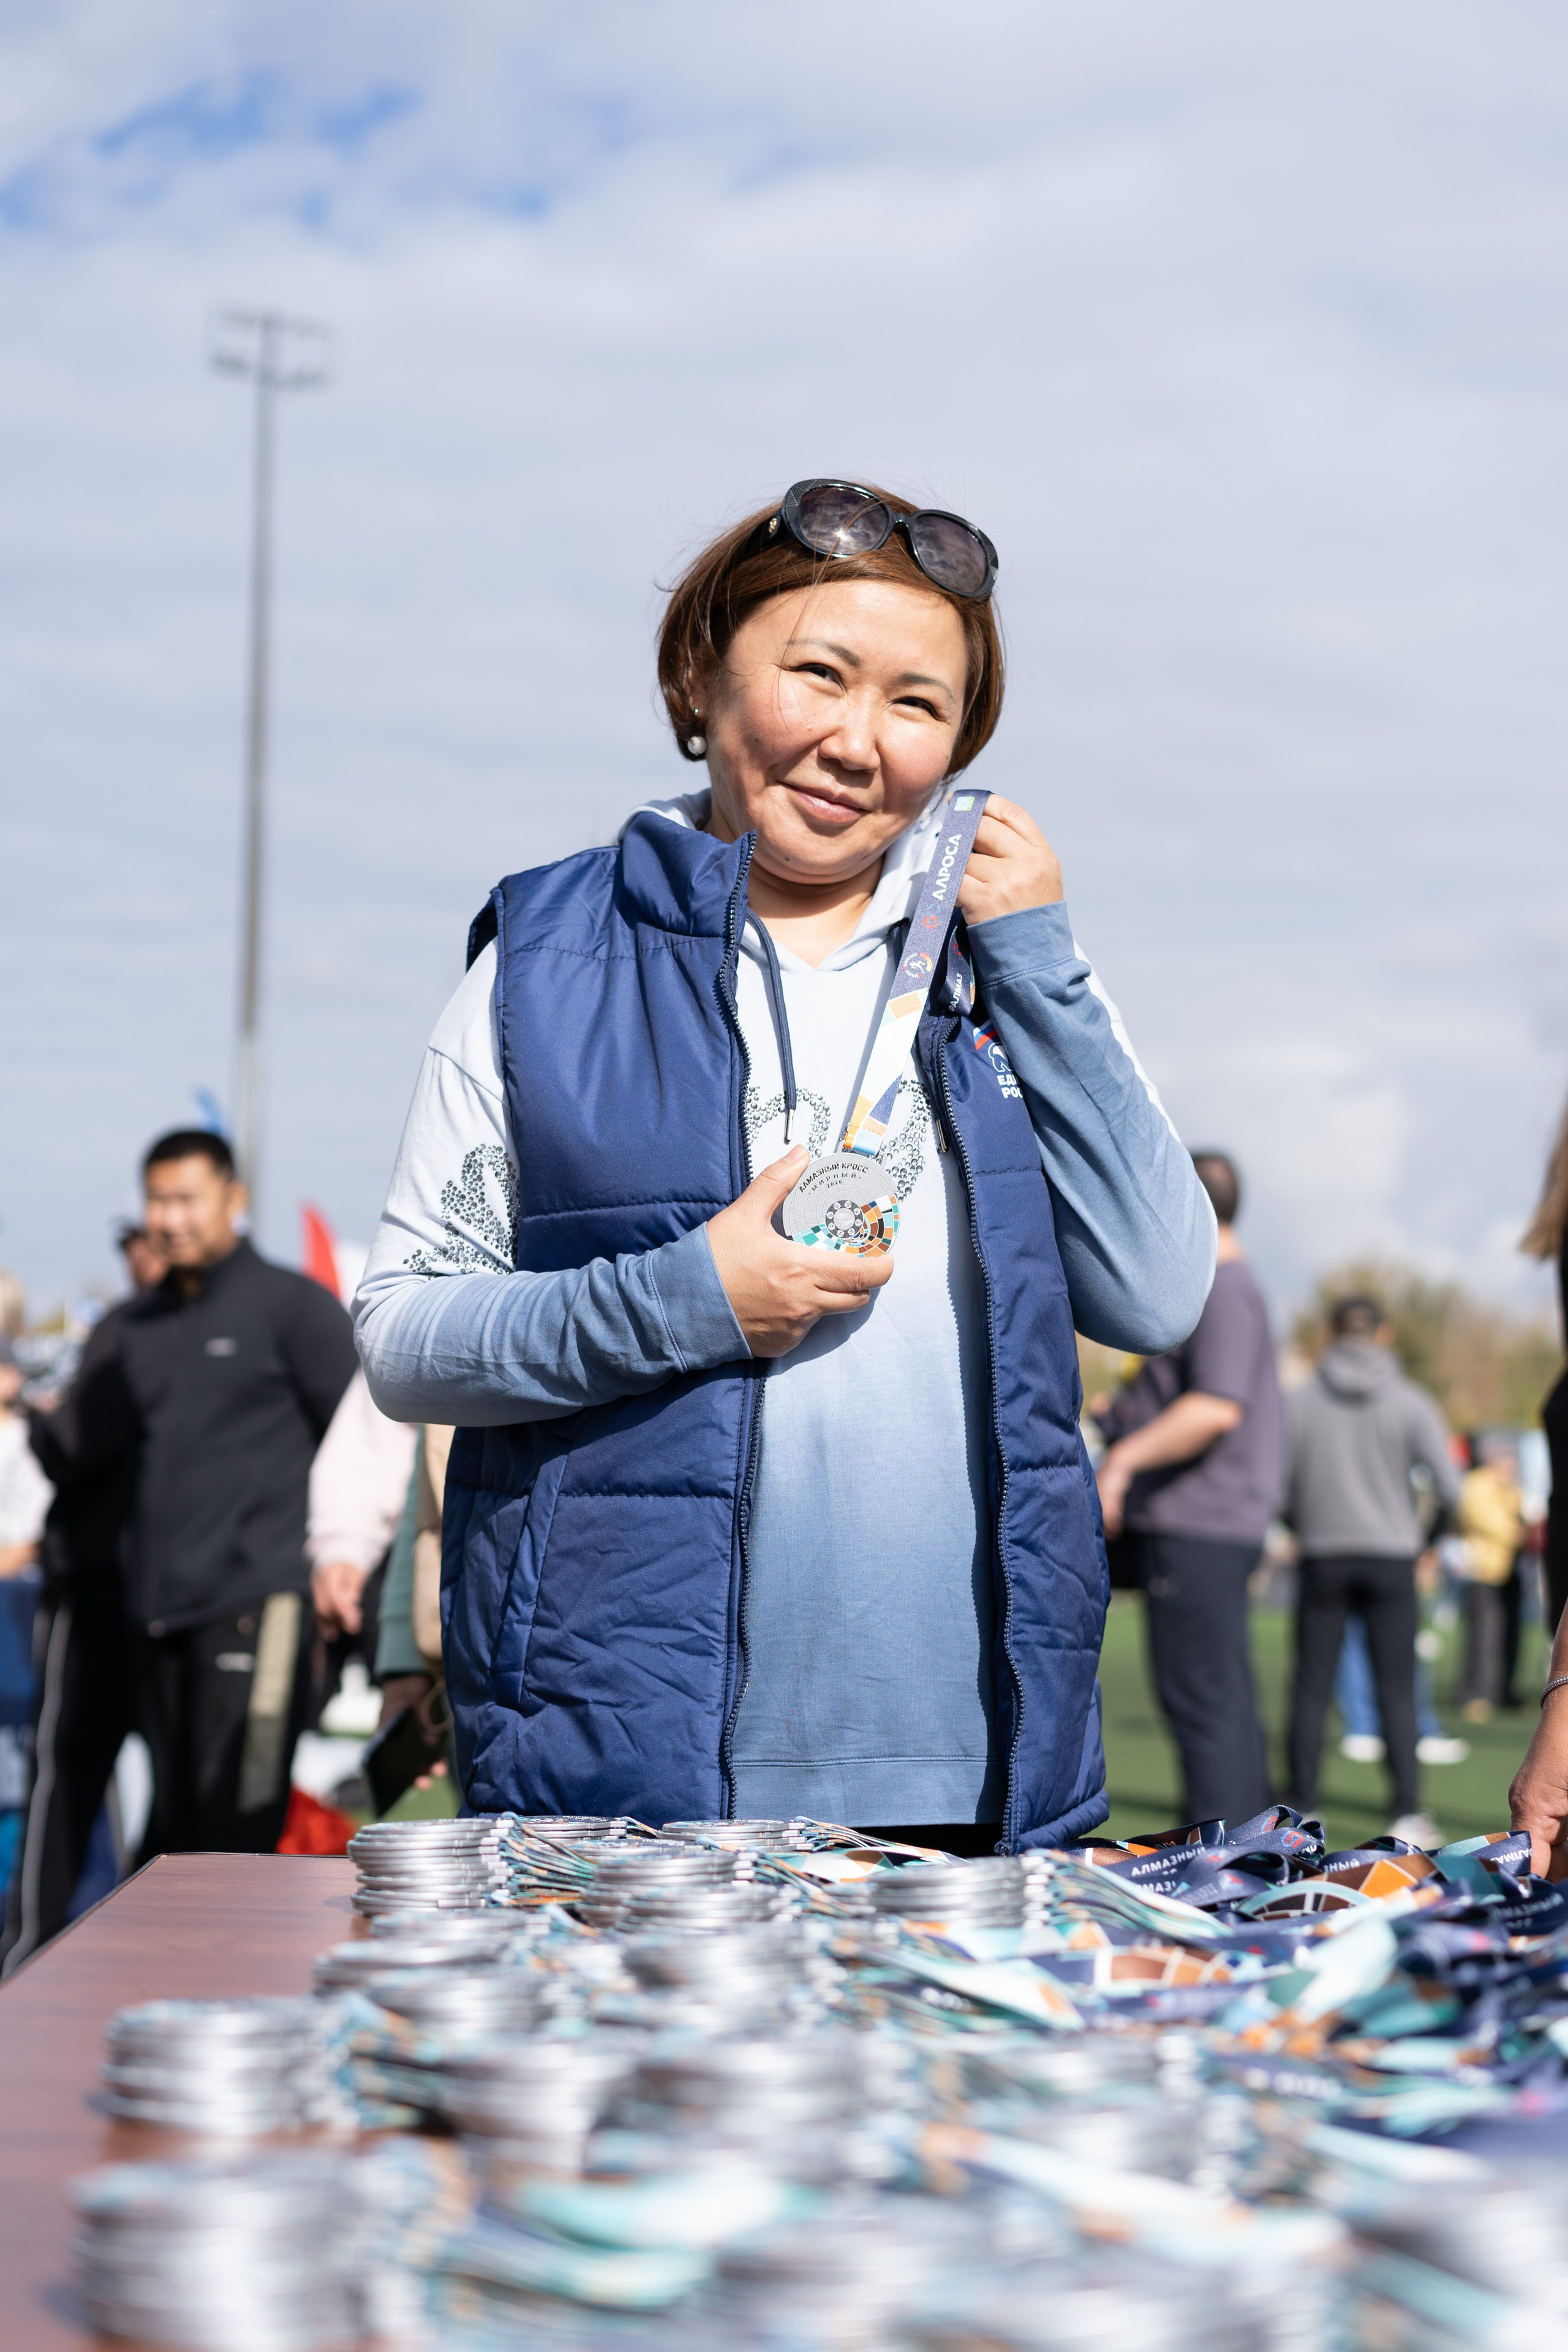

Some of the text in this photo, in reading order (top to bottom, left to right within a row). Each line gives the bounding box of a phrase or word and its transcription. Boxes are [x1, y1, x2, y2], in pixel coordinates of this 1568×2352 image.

[932, 834, 962, 901] АЛРОСА
[799, 1161, 869, 1193] АЛМАЗНЫЙ КРОСС
